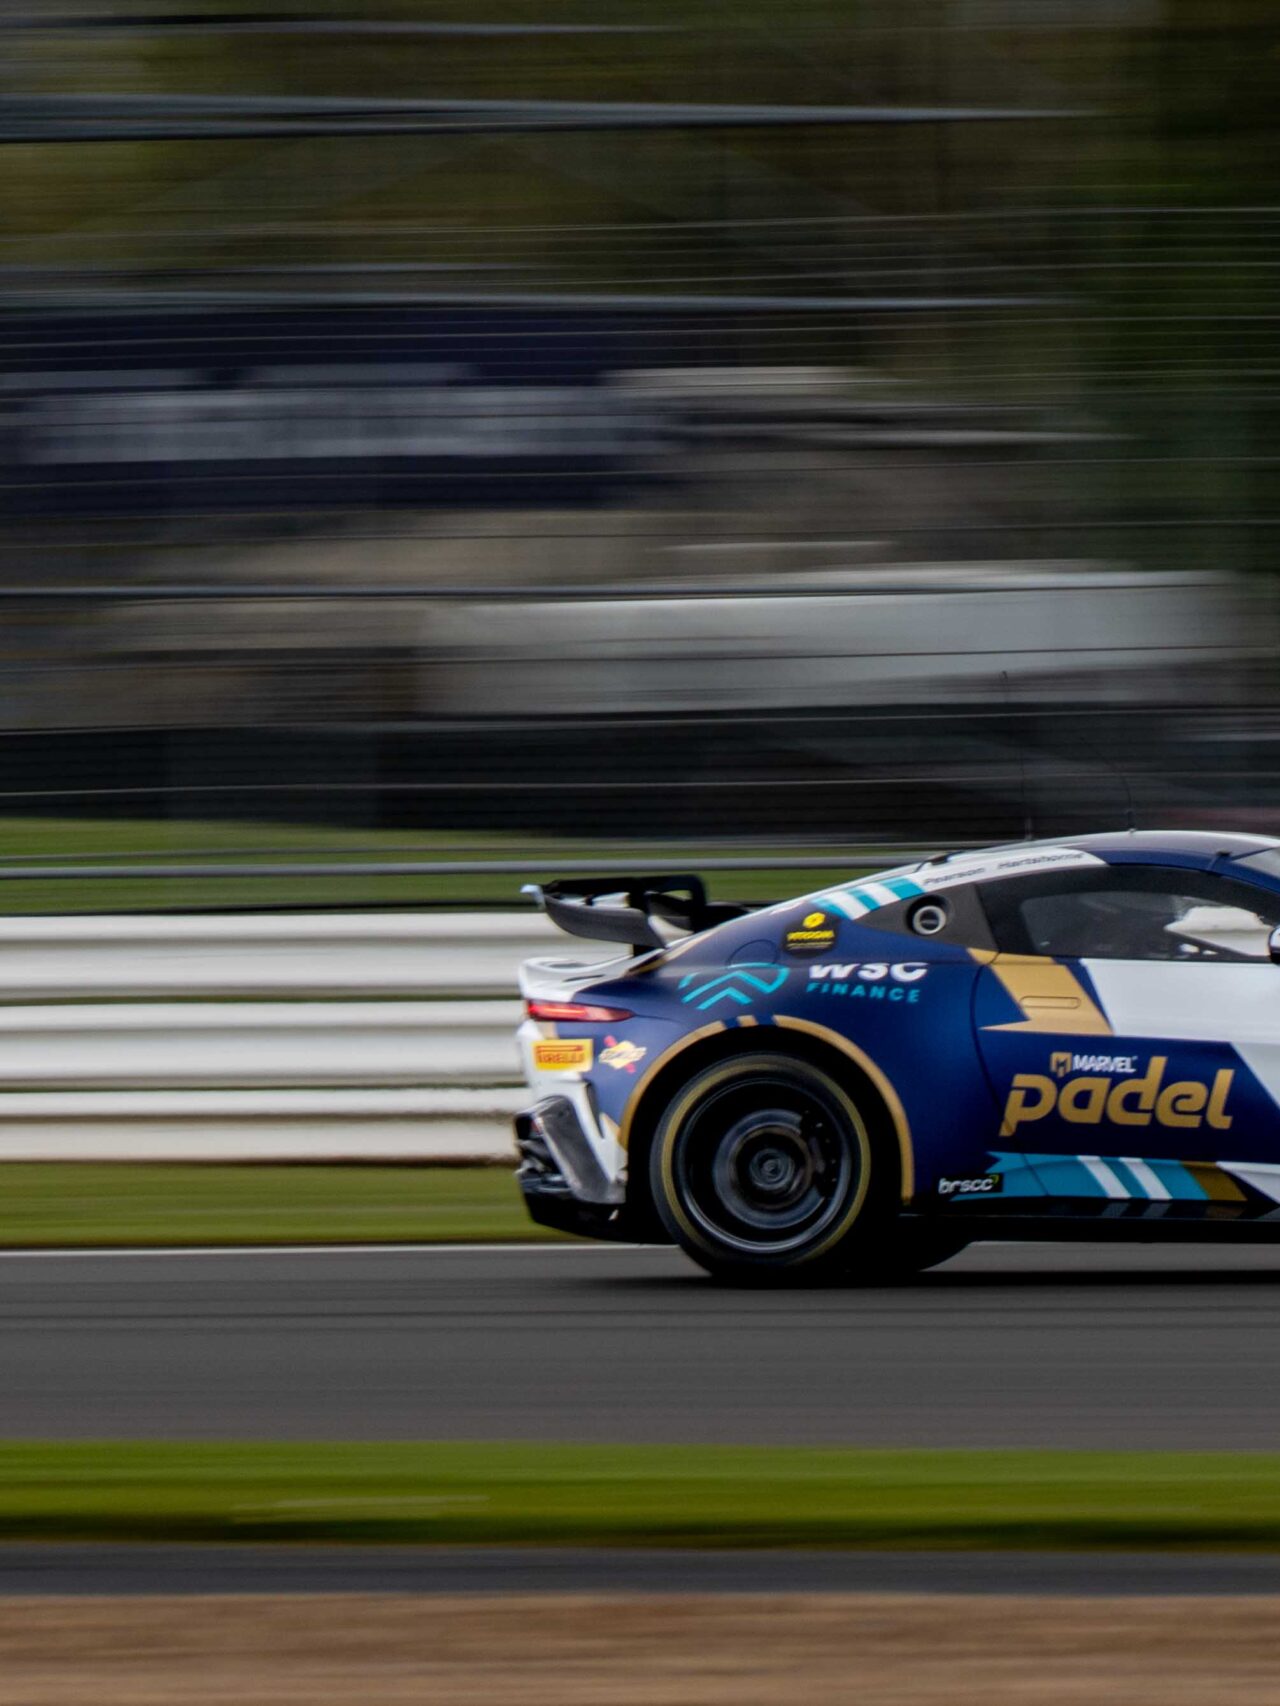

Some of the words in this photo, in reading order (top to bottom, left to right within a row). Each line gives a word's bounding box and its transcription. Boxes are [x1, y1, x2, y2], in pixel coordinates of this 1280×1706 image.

[808, 962, 930, 982] WSC
[806, 982, 922, 1004] FINANCE
[1073, 1054, 1137, 1073] MARVEL
[999, 1056, 1235, 1137] padel
[938, 1177, 993, 1194] brscc
